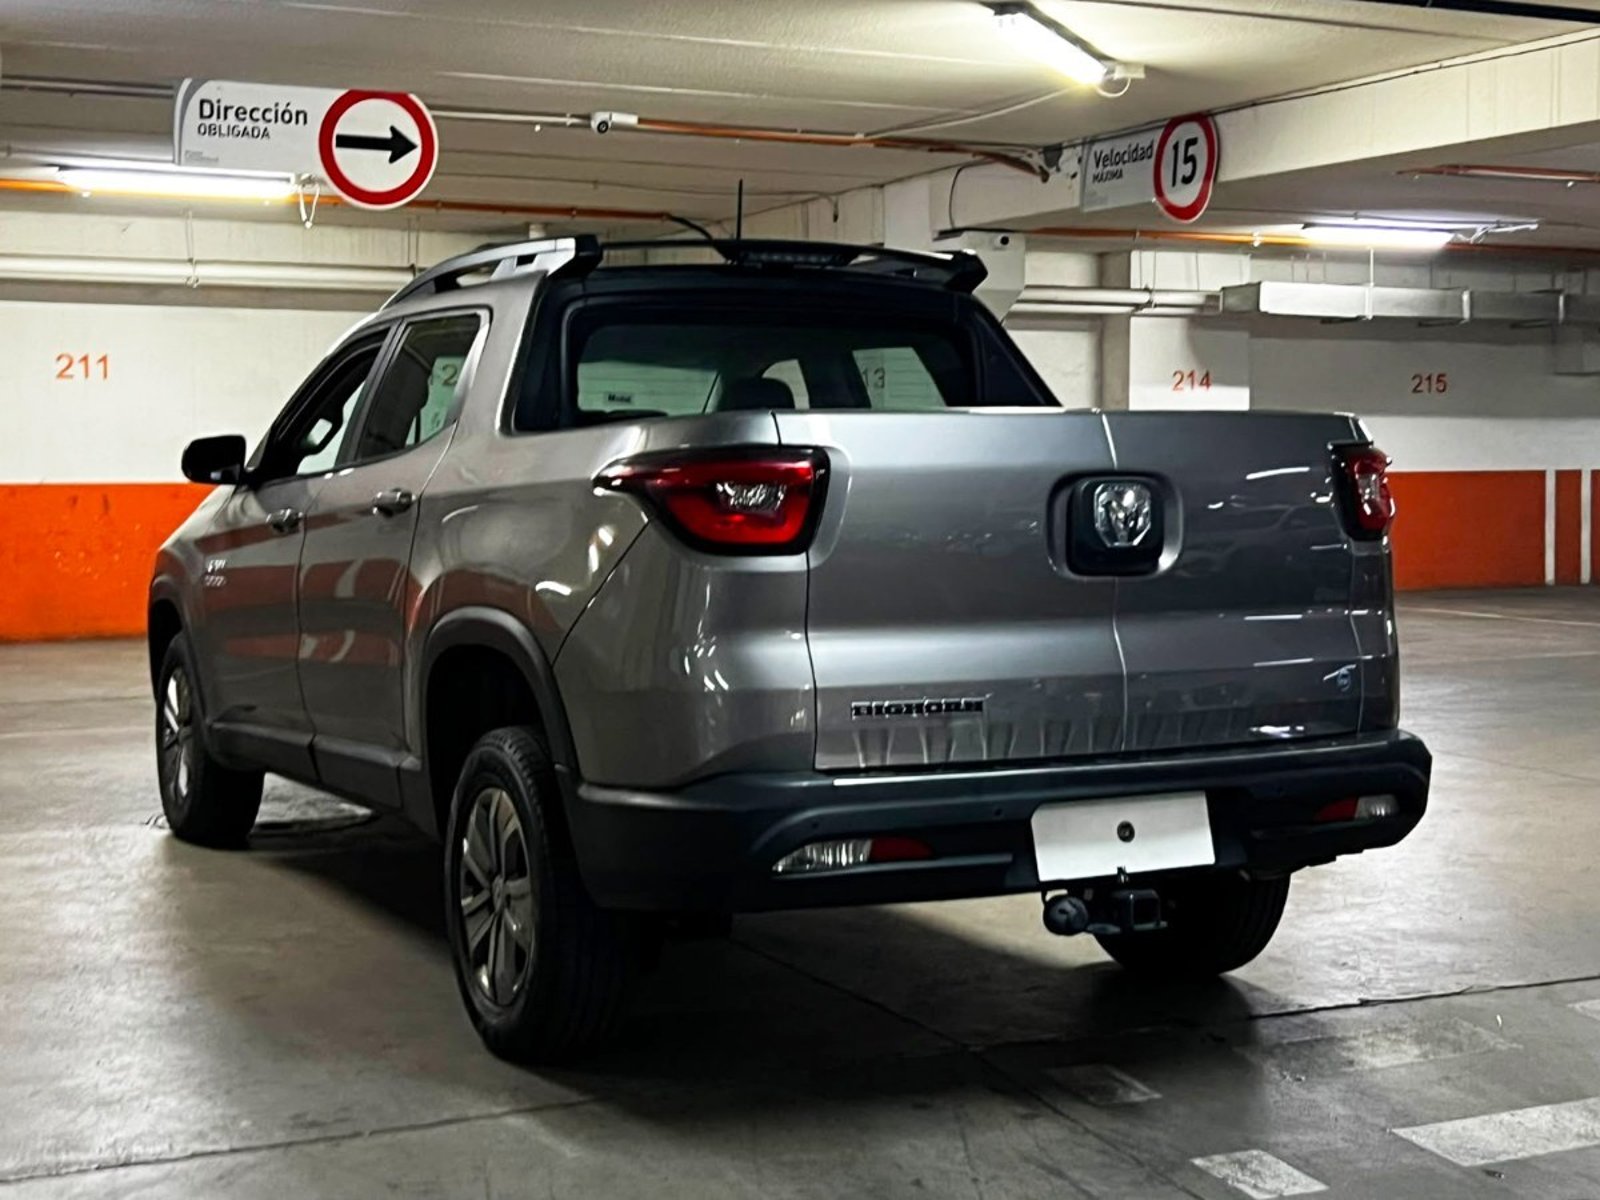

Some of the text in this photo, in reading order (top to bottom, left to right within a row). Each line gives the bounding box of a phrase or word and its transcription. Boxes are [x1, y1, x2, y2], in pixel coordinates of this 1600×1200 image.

[198, 99, 308, 126] Dirección
[197, 123, 271, 140] OBLIGADA
[1094, 139, 1154, 168] Velocidad
[1171, 137, 1198, 187] 15
[56, 353, 107, 379] 211
[1173, 370, 1212, 391] 214
[1411, 373, 1447, 393] 215
